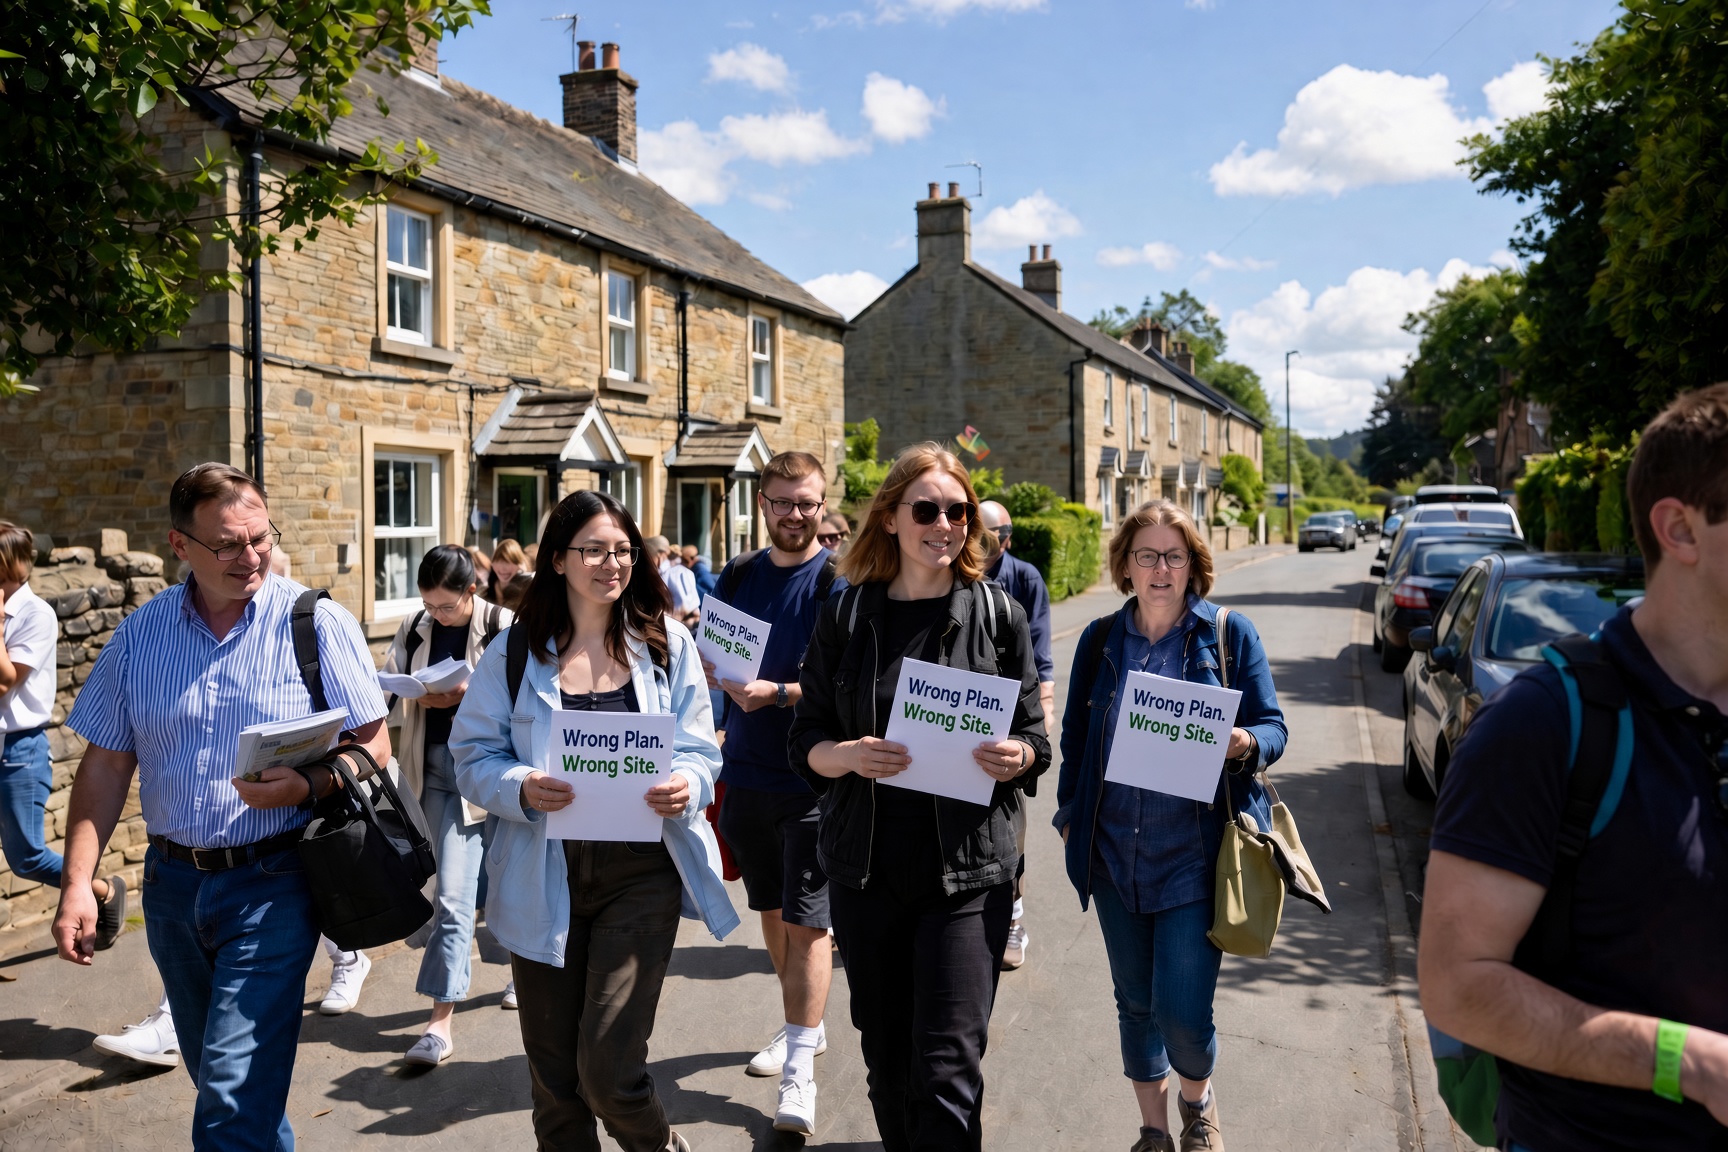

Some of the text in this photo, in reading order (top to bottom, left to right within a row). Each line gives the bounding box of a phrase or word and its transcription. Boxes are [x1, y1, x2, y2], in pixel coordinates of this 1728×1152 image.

[704, 625, 752, 661] Wrong Site.
[707, 610, 759, 645] Wrong Plan.
[909, 677, 1004, 712] Wrong Plan.
[1134, 688, 1226, 721] Wrong Plan.
[904, 702, 994, 736] Wrong Site.
[1129, 712, 1217, 745] Wrong Site.
[563, 729, 664, 752] Wrong Plan.
[562, 754, 659, 778] Wrong Site.
